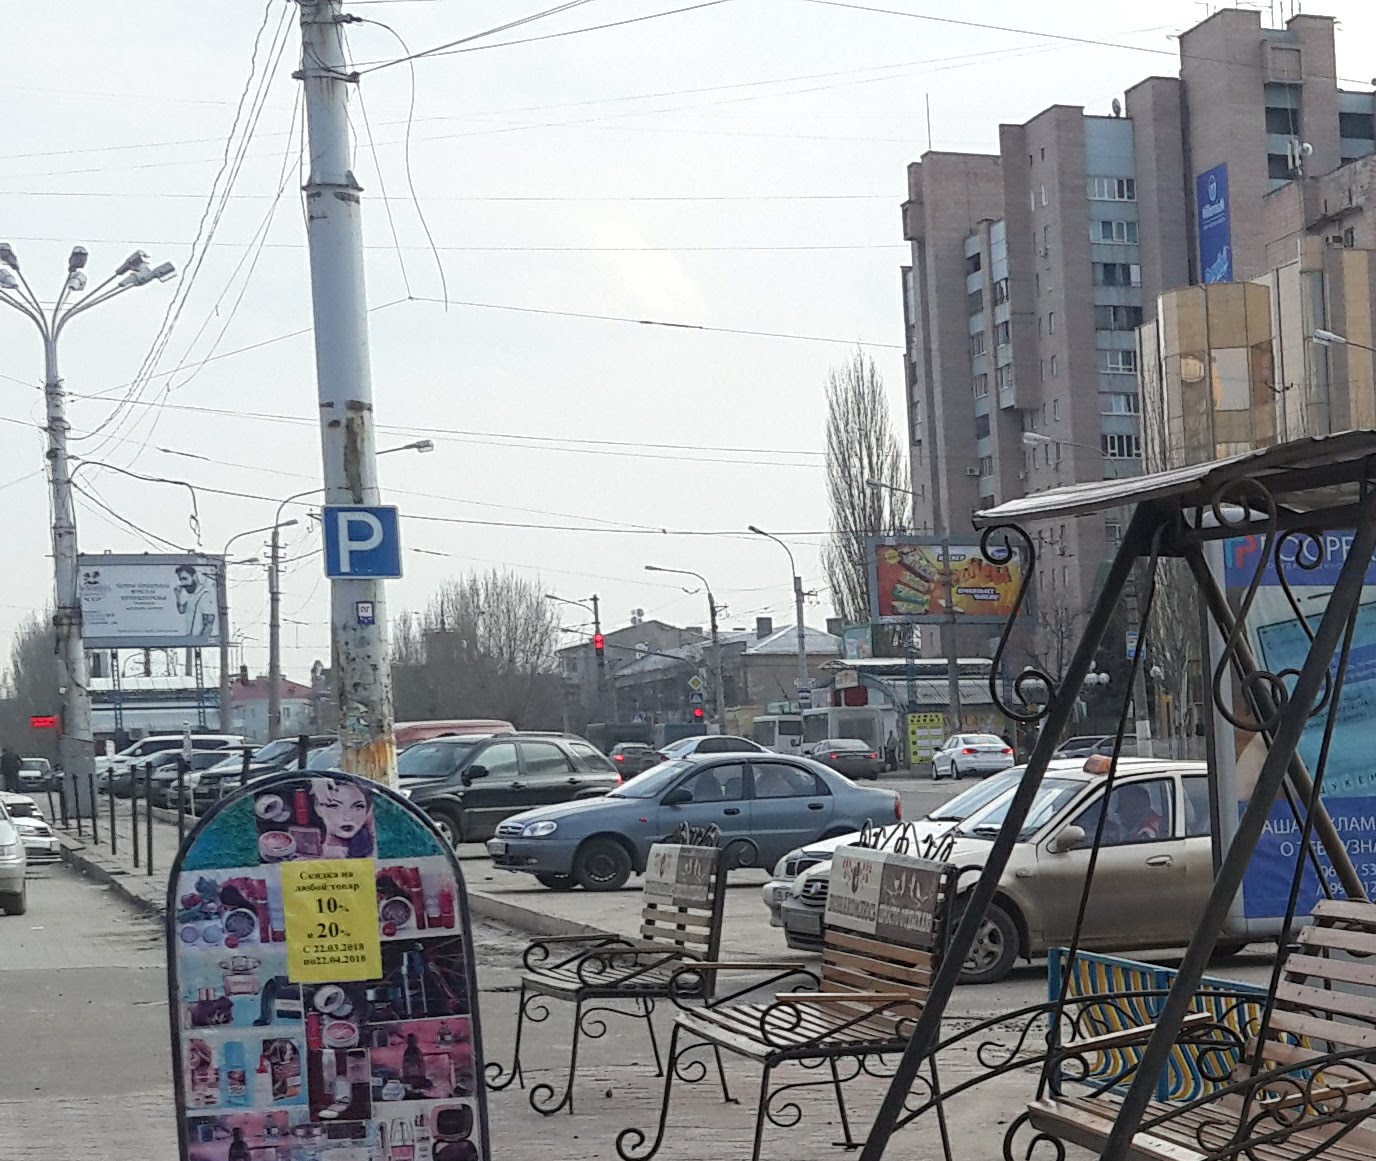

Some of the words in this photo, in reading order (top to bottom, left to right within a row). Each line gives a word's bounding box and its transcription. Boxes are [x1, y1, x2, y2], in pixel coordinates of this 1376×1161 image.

[338, 511, 384, 573] P
[1259, 818, 1302, 835] АША
[1280, 841, 1294, 857] О
[299, 871, 339, 880] Скидка
[294, 883, 328, 892] любой
[331, 883, 360, 892] товар
[314, 943, 365, 953] 22.03.2018
